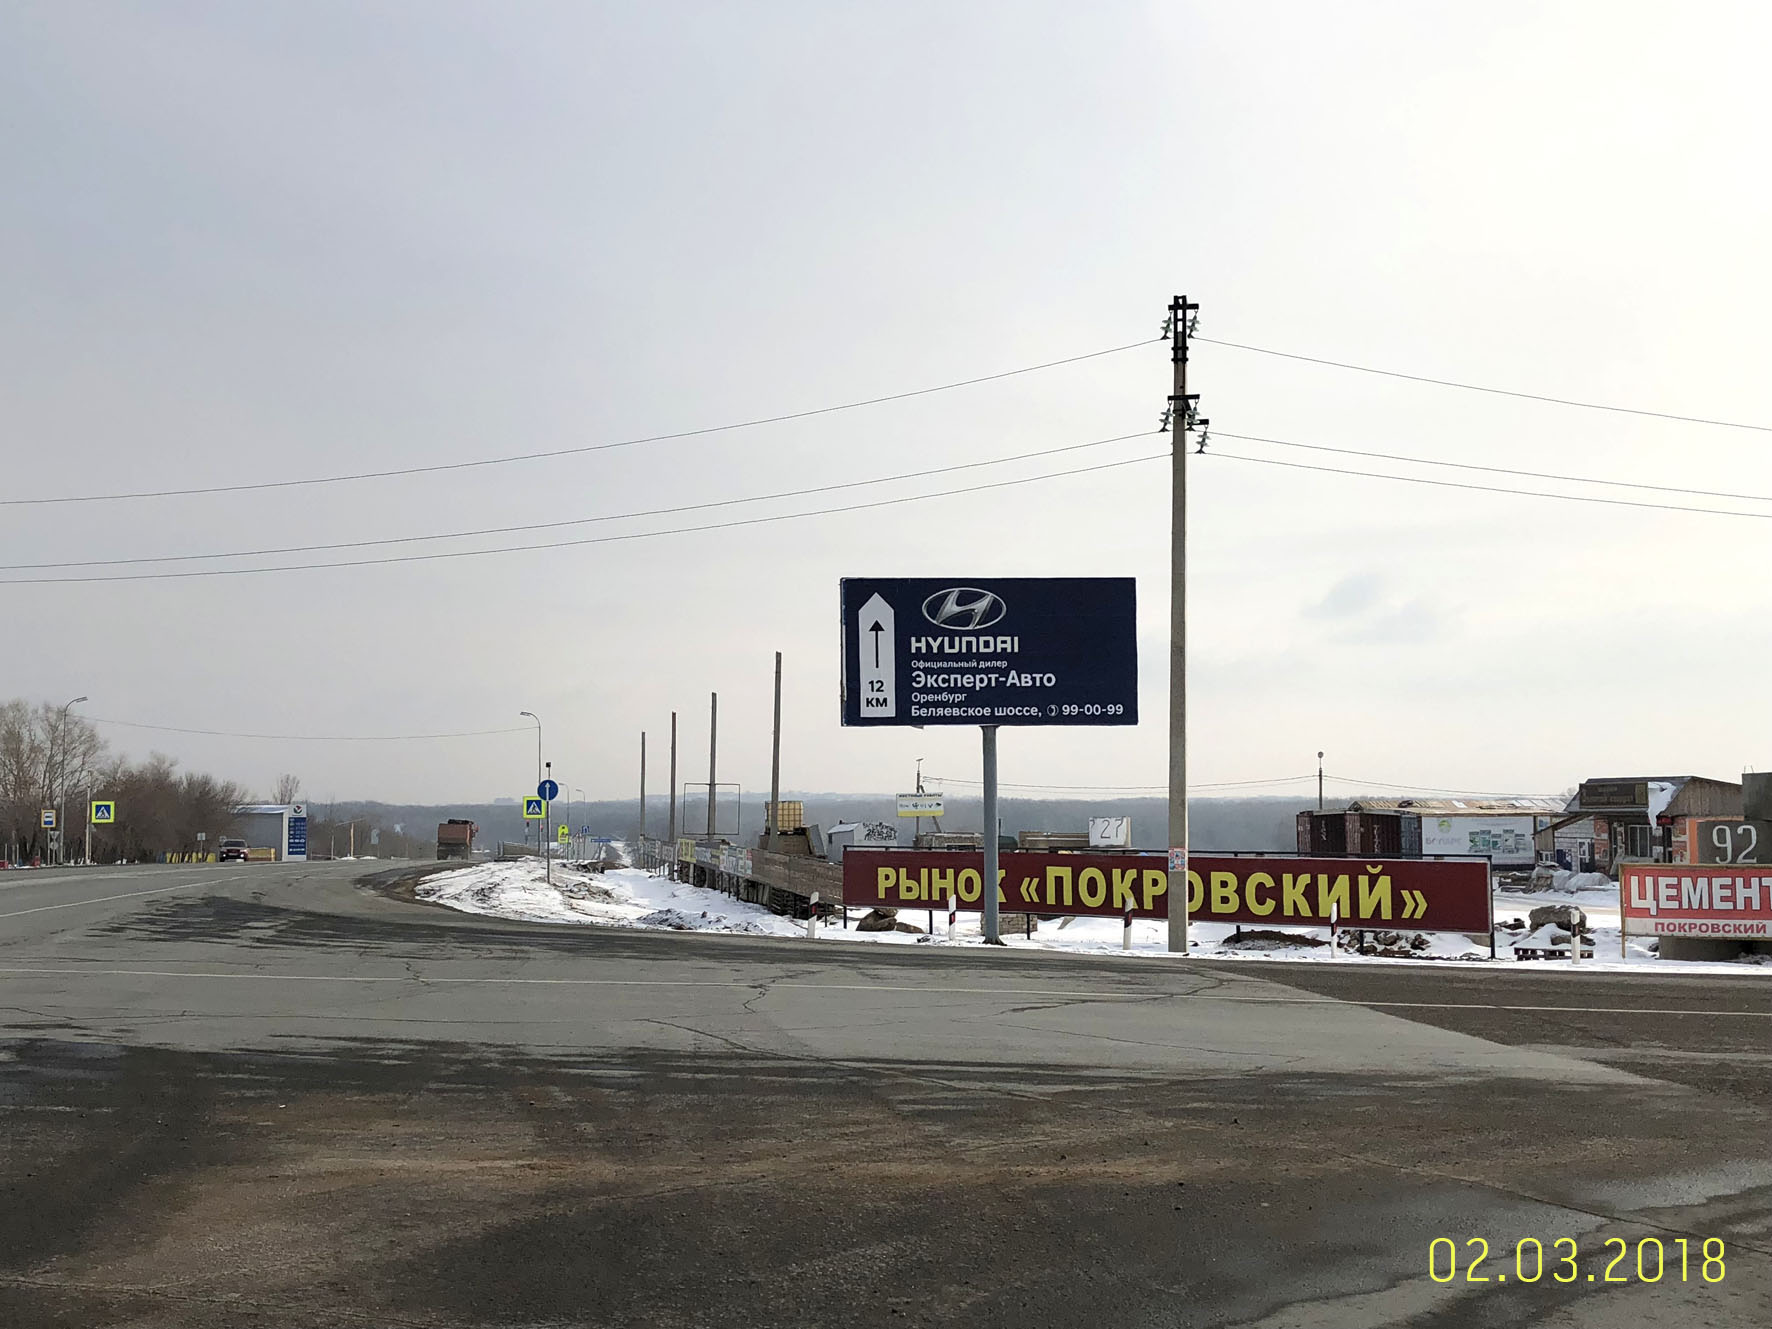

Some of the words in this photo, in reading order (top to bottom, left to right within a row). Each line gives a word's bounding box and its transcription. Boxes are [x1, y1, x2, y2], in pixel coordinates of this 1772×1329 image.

[910, 636, 1019, 653] HYUNDAI
[911, 659, 977, 669] Официальный
[978, 660, 1008, 669] дилер
[868, 680, 885, 692] 12
[911, 670, 1057, 691] Эксперт-Авто
[865, 697, 888, 707] КМ
[911, 692, 968, 703] Оренбург
[911, 705, 991, 717] Беляевское
[994, 706, 1042, 717] шоссе,
[1061, 704, 1124, 716] 99-00-99
[1712, 824, 1758, 864] 92
[1654, 921, 1767, 934] ПОКРОВСКИЙ
